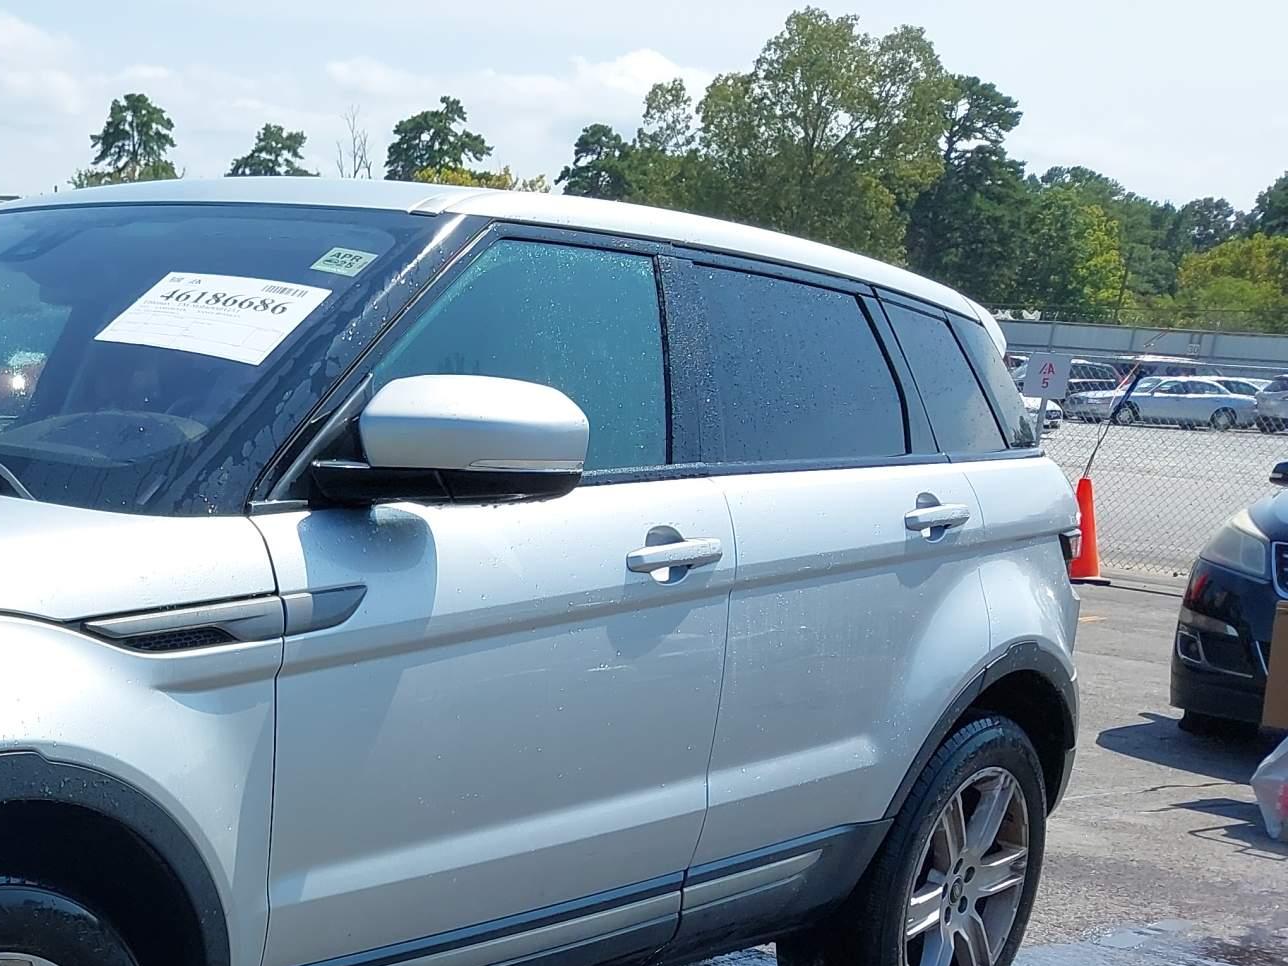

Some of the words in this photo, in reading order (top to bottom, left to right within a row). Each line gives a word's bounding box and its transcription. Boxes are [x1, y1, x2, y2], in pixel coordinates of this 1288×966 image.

[330, 252, 363, 262] APR
[160, 288, 295, 315] 46186686
[1040, 377, 1049, 389] 5
